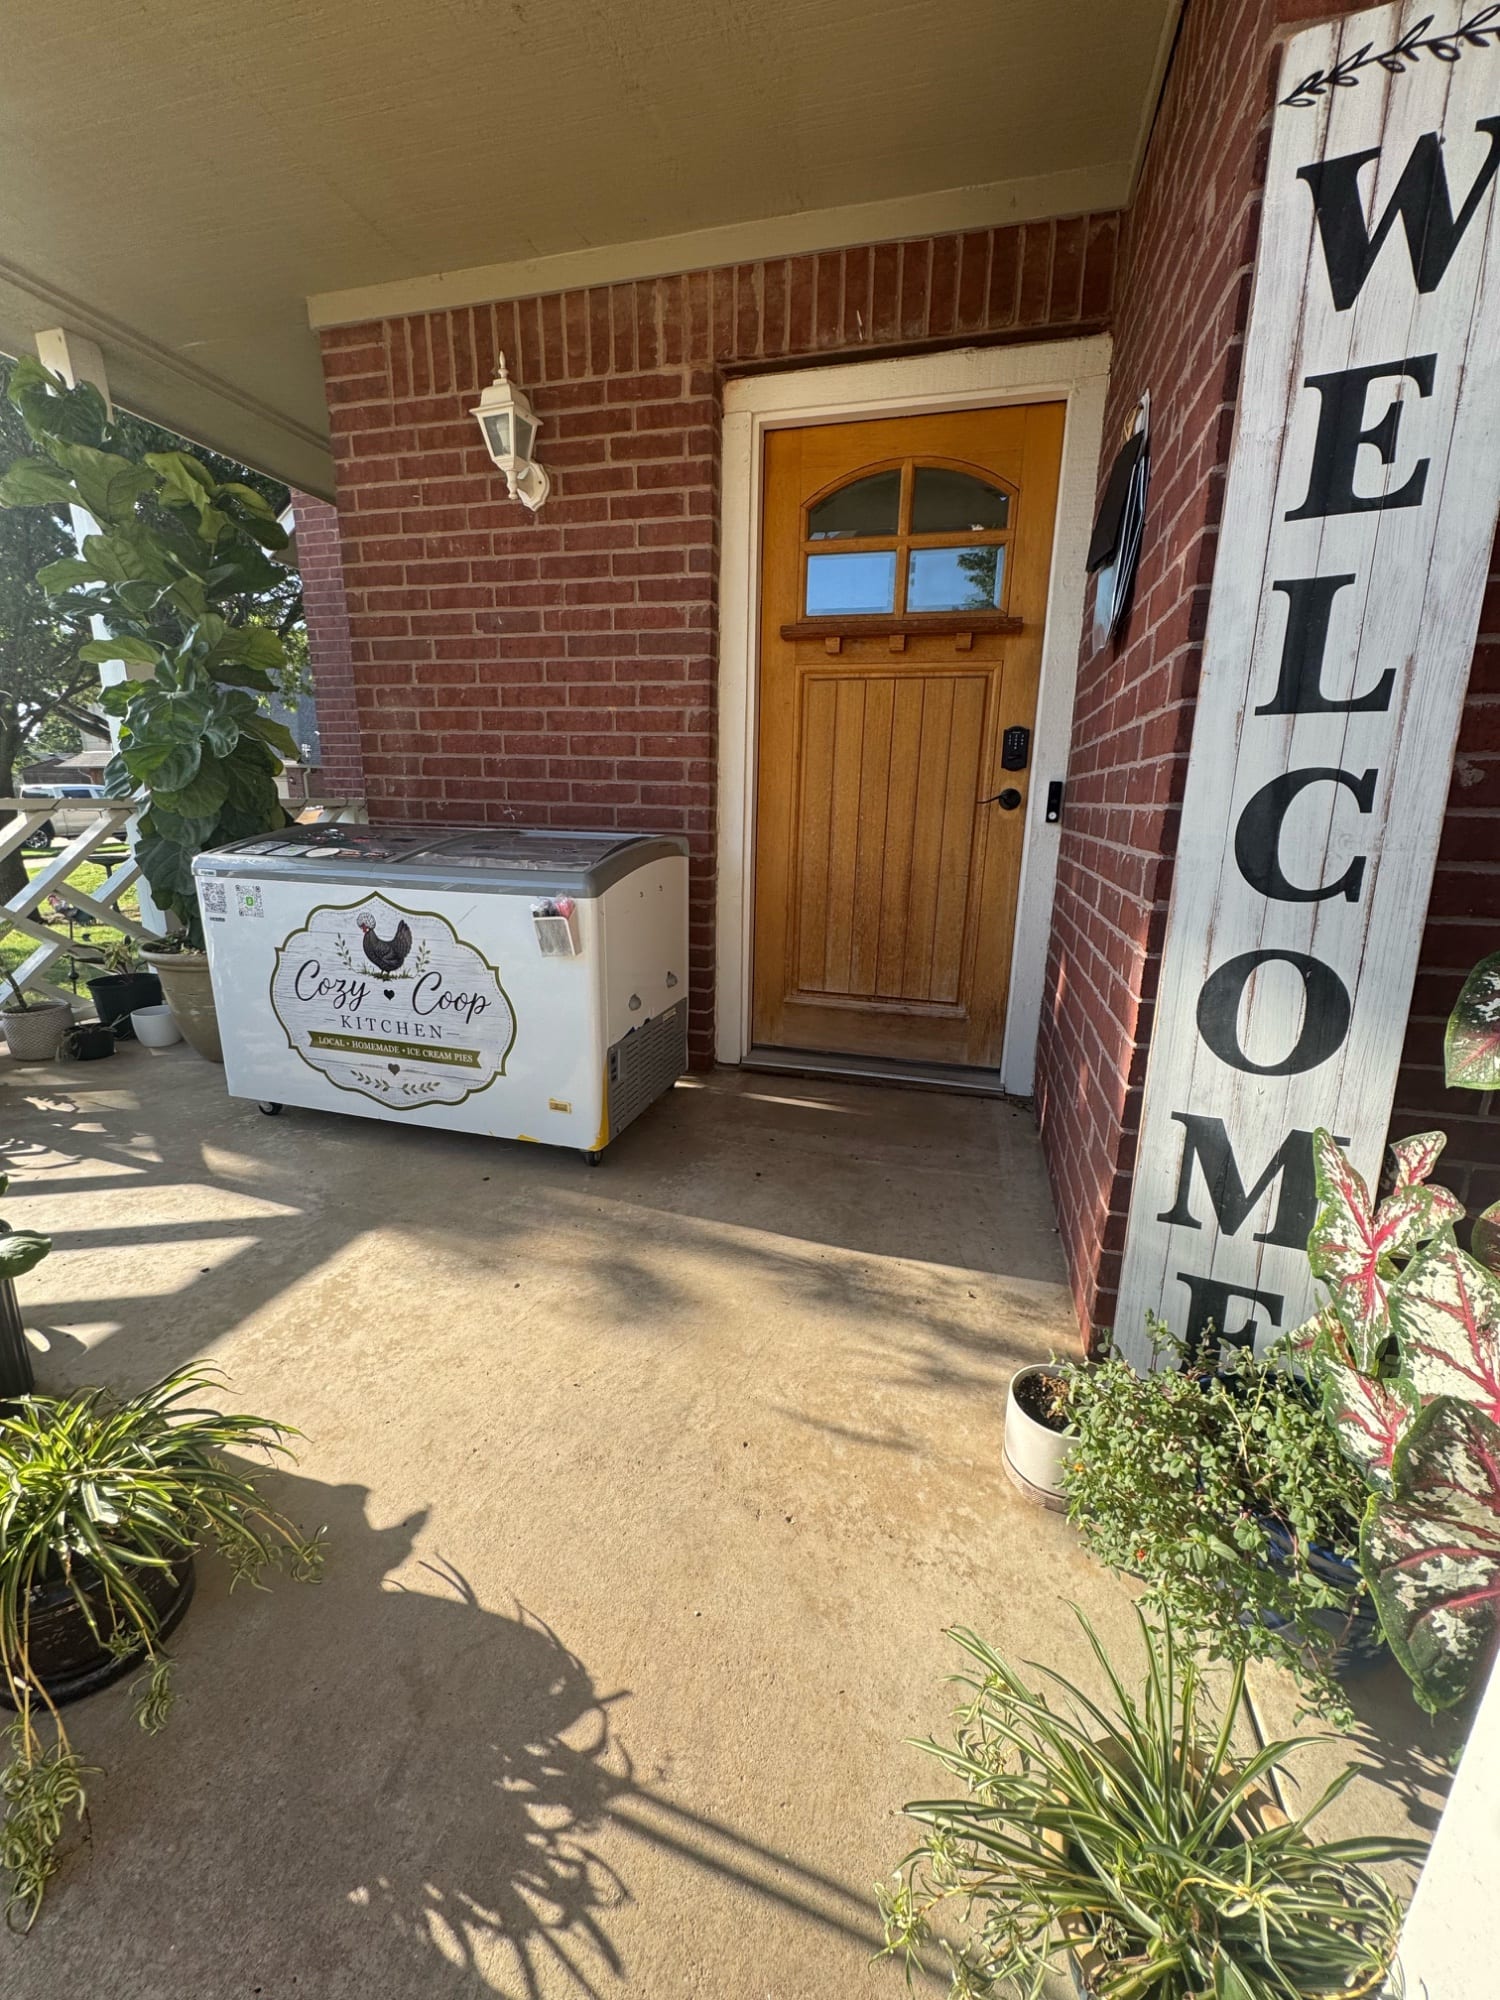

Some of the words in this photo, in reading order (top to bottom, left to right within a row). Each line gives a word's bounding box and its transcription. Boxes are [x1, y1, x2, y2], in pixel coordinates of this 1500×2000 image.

[1156, 116, 1500, 1371] WELCOME
[295, 959, 370, 1011] Cozy
[412, 971, 492, 1024] Coop
[318, 1036, 345, 1047] LOCAL
[352, 1041, 400, 1054] HOMEMADE
[406, 1047, 421, 1057] ICE
[421, 1048, 452, 1060] CREAM
[454, 1052, 473, 1063] PIES
[340, 1014, 443, 1039] KITCHEN
